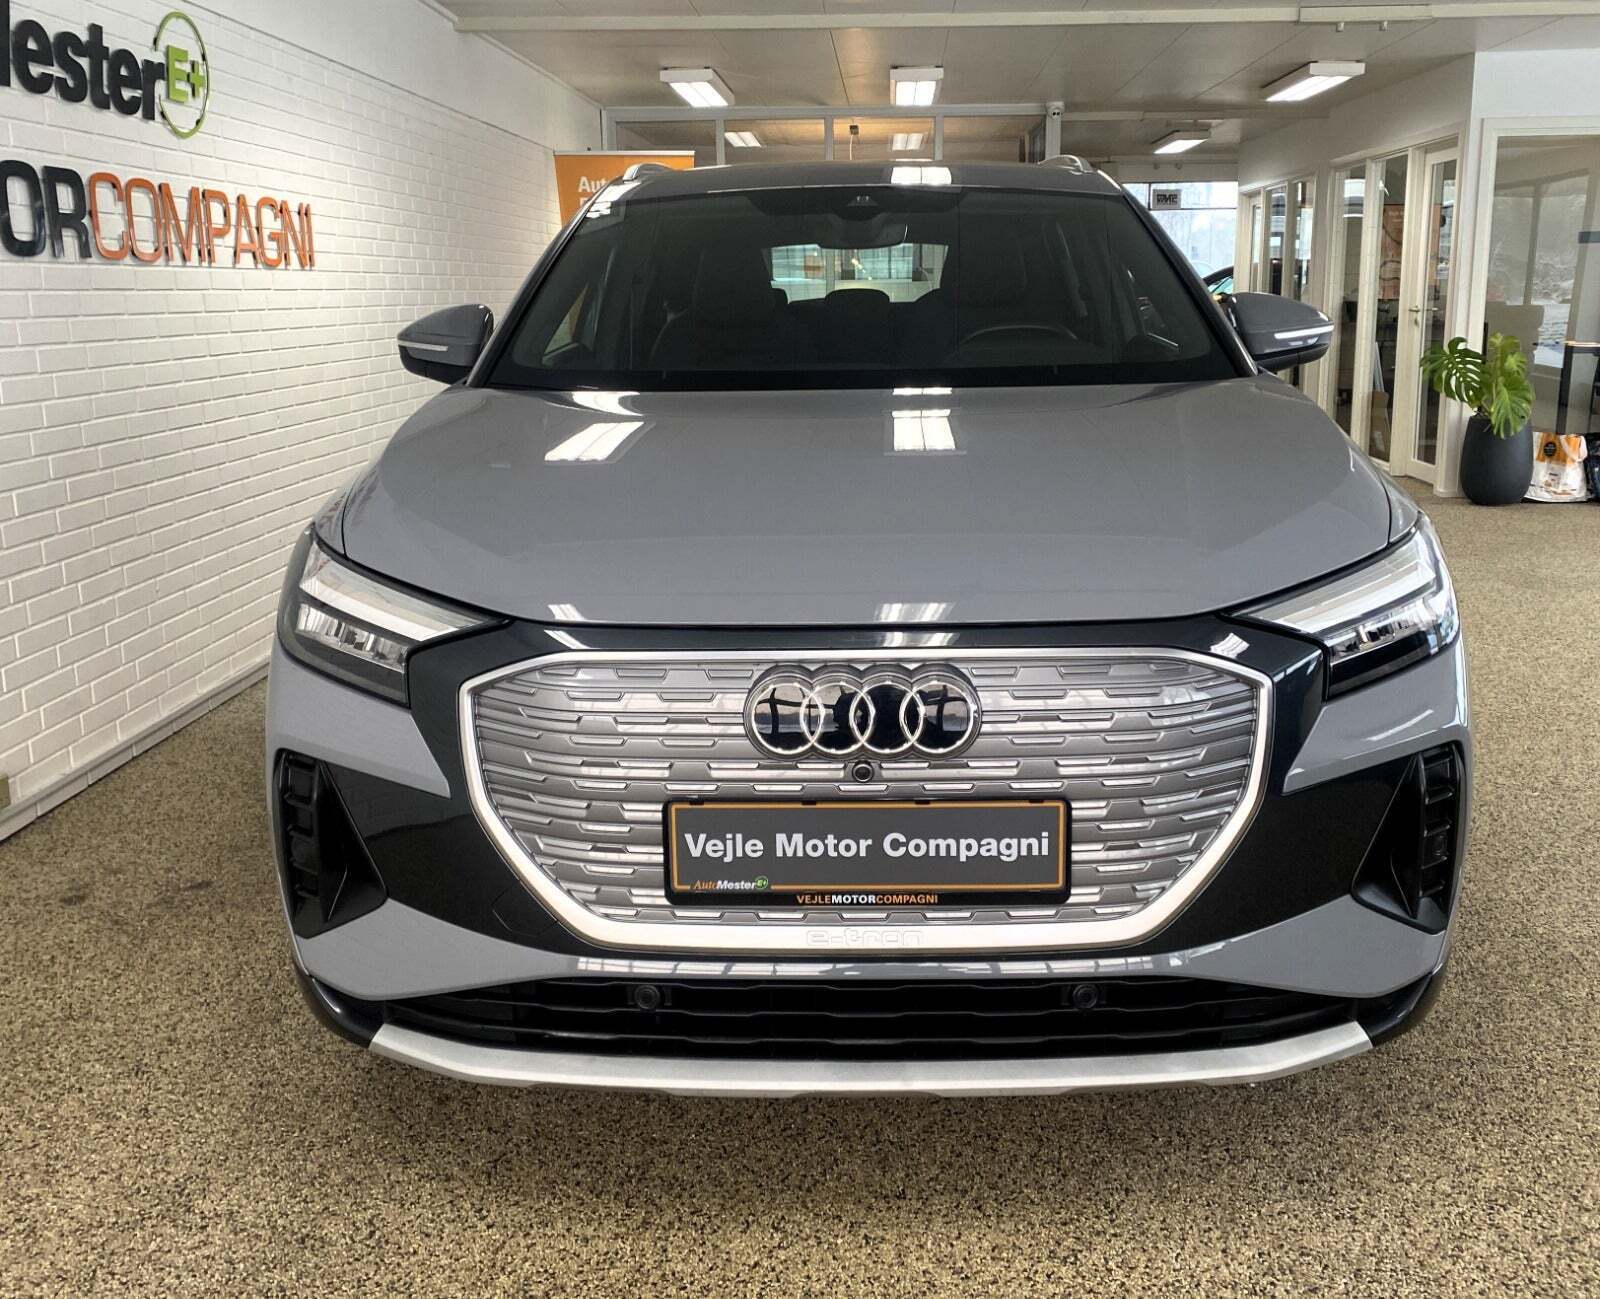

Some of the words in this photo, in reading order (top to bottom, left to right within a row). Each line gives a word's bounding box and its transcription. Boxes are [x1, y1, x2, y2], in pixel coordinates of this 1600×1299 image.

[0, 0, 166, 121] ester
[684, 833, 764, 862] Vejle
[775, 833, 872, 857] Motor
[883, 832, 1049, 862] Compagni
[797, 894, 938, 904] VEJLEMOTORCOMPAGNI
[806, 928, 924, 946] e-tron
